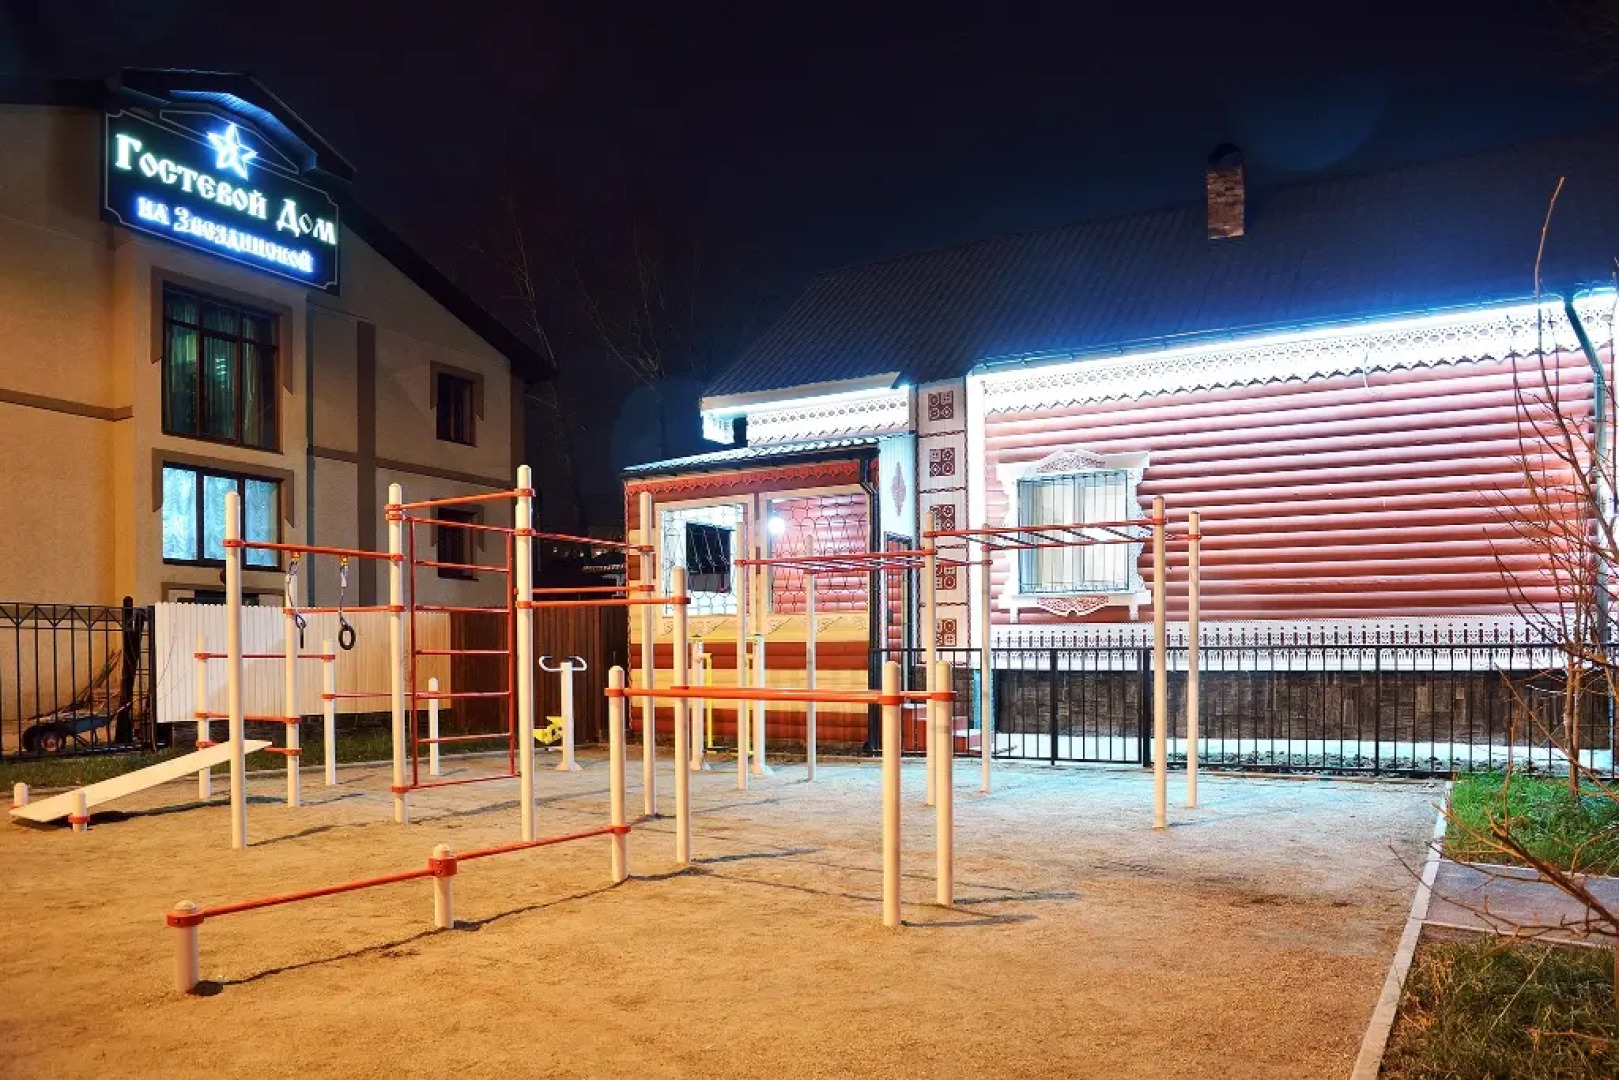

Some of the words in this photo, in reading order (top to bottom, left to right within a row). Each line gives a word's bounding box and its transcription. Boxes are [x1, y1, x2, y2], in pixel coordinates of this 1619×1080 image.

[115, 133, 267, 219] Гостевой
[276, 198, 336, 245] Дом
[137, 197, 170, 225] на
